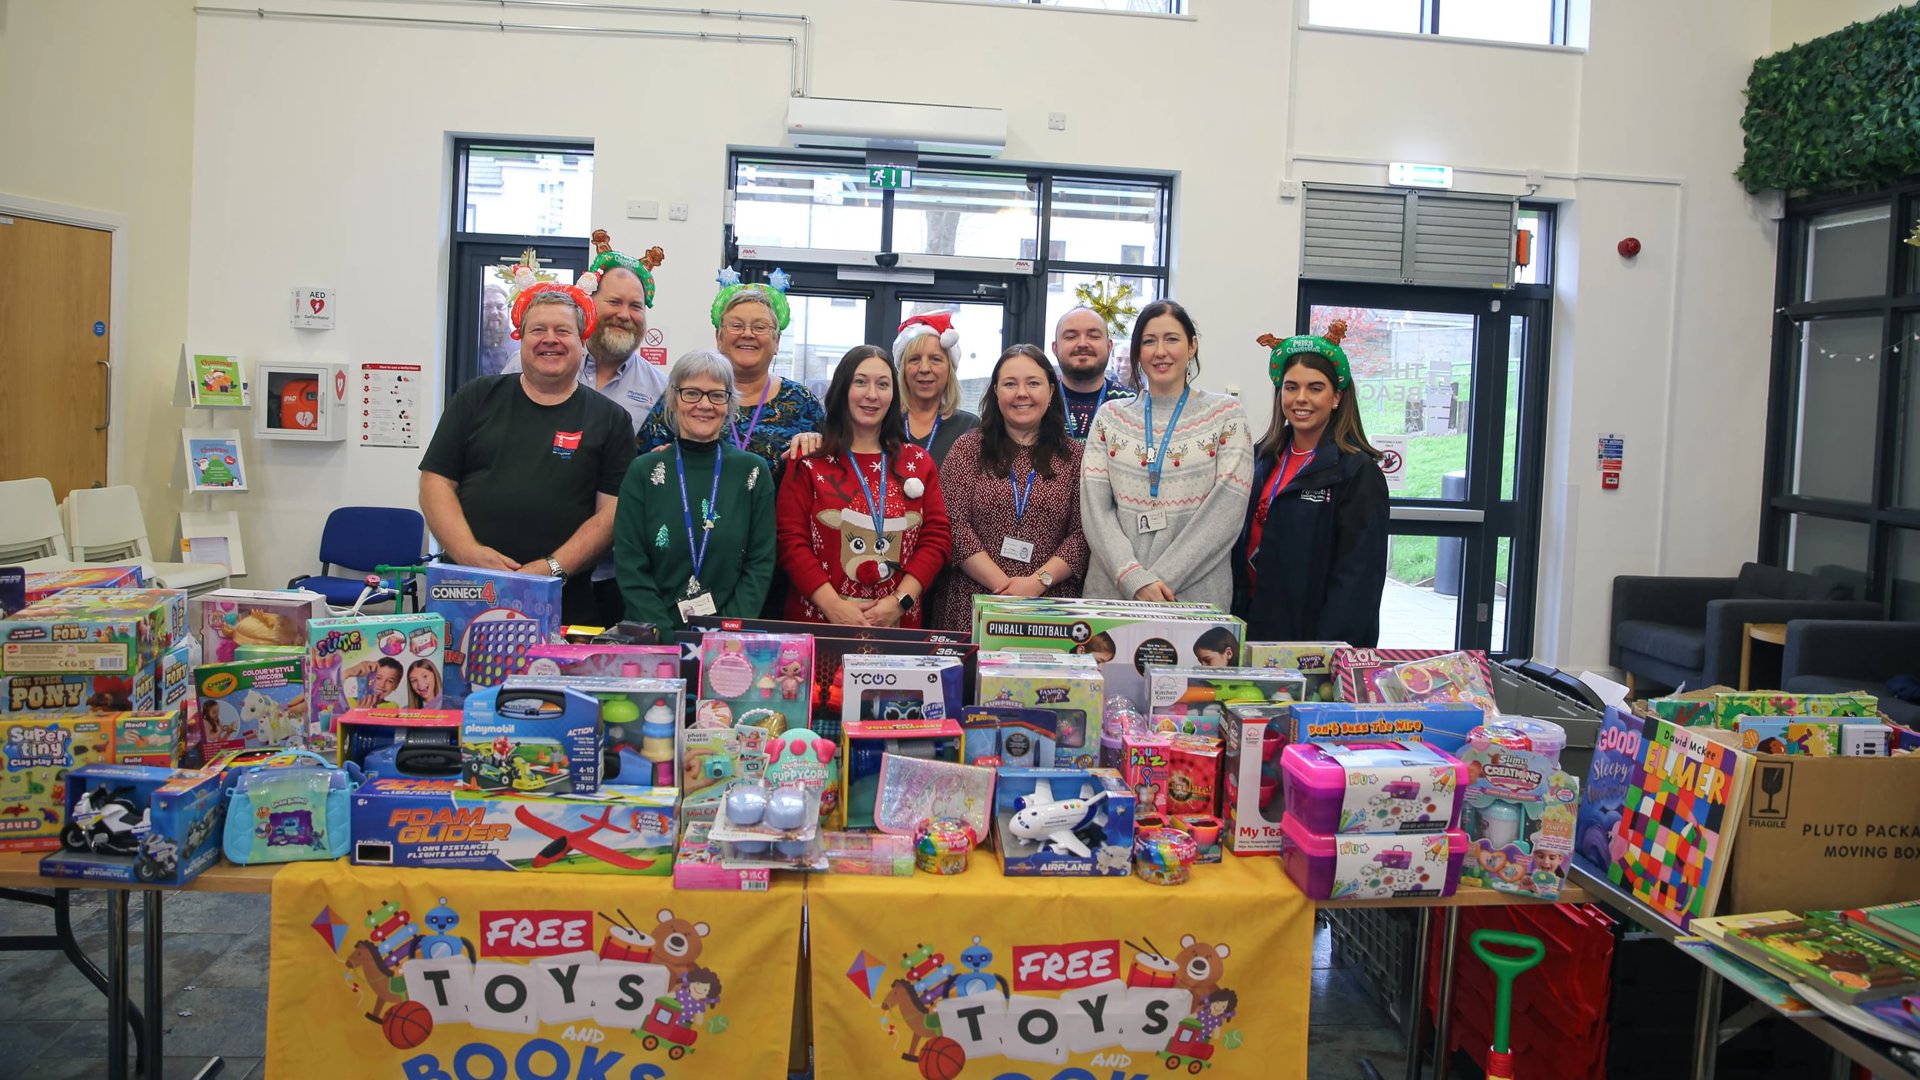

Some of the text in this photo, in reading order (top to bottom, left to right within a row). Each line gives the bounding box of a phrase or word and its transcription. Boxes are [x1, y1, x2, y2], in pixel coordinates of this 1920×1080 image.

[310, 291, 326, 299] AED
[431, 580, 496, 603] CONNECT 4
[52, 628, 88, 641] PONY
[989, 623, 1068, 638] PINBALL FOOTBALL
[208, 678, 232, 688] Crayola
[11, 682, 84, 712] PONY
[466, 724, 515, 734] playmobil
[567, 727, 594, 737] ACTION
[1308, 720, 1423, 738] Don't Buzz The Wire
[20, 741, 63, 759] tiny
[1598, 726, 1640, 760] GOOD
[1664, 730, 1716, 760] David McKee
[1131, 748, 1158, 757] POUR
[10, 758, 67, 767] Clay play set
[1131, 756, 1168, 767] PALZ
[1500, 754, 1528, 768] Slimy
[772, 770, 830, 782] PUPPYCORN
[1484, 765, 1541, 784] CREATIONS
[1594, 759, 1629, 782] Sleepy
[1643, 740, 1726, 805] ELMER
[388, 807, 487, 828] FOAM
[1749, 820, 1787, 829] FRAGILE
[398, 822, 512, 844] GLIDER
[1240, 826, 1282, 839] My Tea
[1802, 824, 1858, 837] PLUTO
[418, 844, 440, 852] LONG
[449, 850, 468, 858] AND
[1824, 846, 1888, 859] MOVING
[84, 871, 128, 879] MOTORCYCLE
[1040, 864, 1092, 872] AIRPLANE
[487, 918, 588, 949] FREE
[1019, 948, 1114, 982] FREE
[424, 964, 644, 1014] TOYS
[957, 994, 1170, 1044] TOYS
[561, 1025, 606, 1044] AND
[1091, 1053, 1132, 1069] AND
